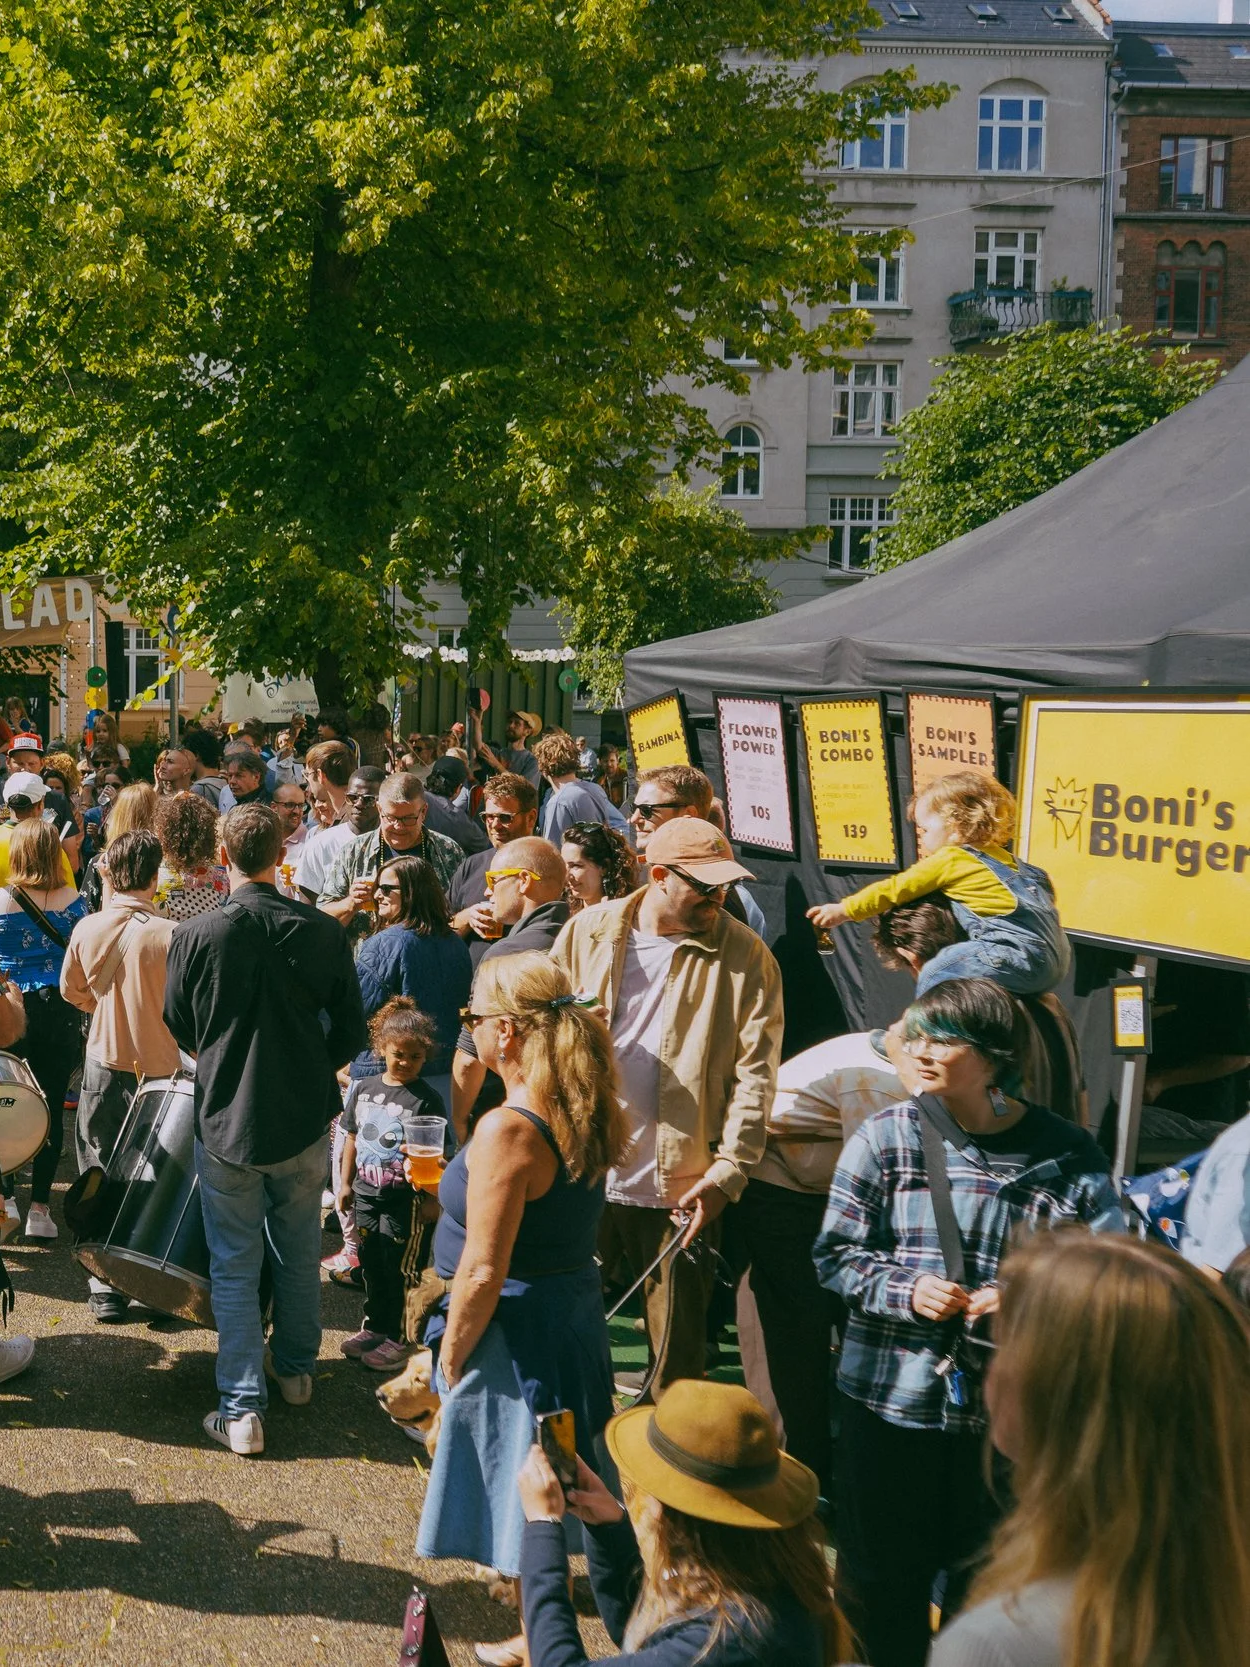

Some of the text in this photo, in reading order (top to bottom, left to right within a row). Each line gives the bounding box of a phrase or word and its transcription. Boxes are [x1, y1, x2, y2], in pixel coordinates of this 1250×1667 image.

[728, 723, 778, 740] FLOWER
[818, 729, 871, 744] BONI'S
[925, 726, 977, 745] BONI'S
[638, 730, 681, 753] BAMBINA
[732, 740, 776, 756] POWER
[819, 748, 874, 762] COMBO
[918, 743, 988, 767] SAMPLER
[751, 805, 771, 820] 105
[843, 824, 868, 839] 139
